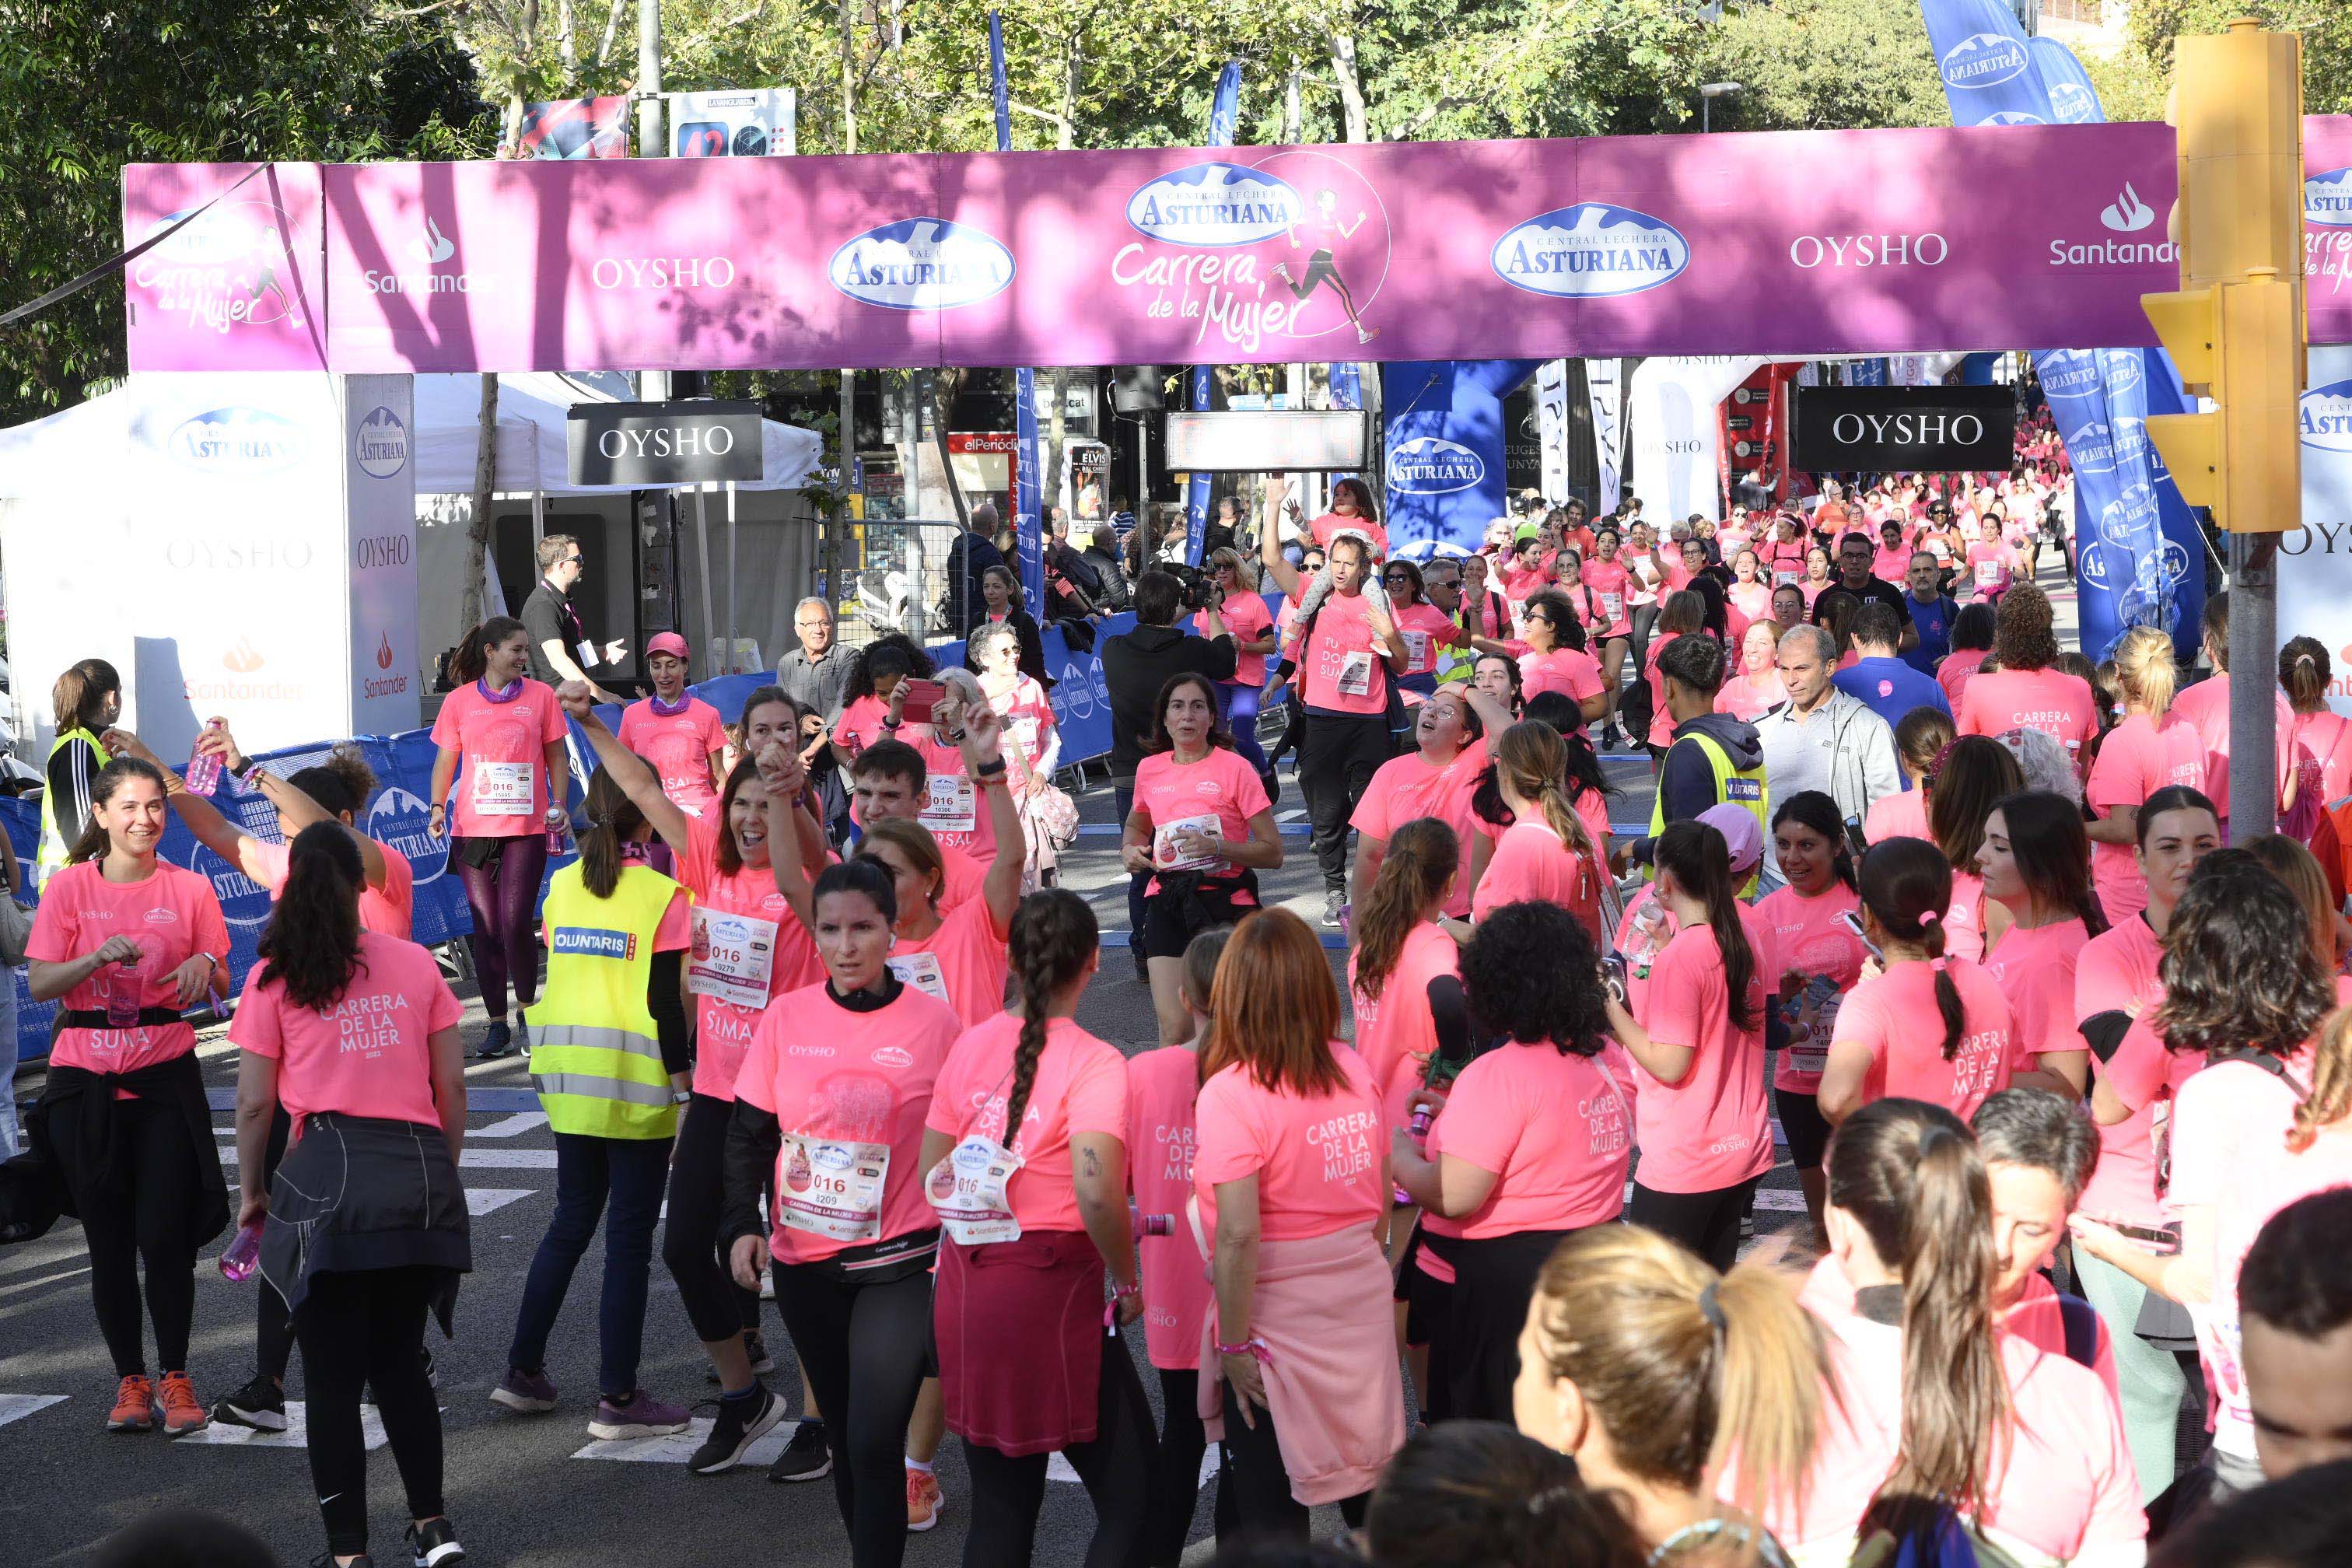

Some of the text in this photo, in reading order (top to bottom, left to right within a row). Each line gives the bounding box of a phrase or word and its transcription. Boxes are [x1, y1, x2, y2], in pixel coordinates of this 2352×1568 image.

[1167, 190, 1223, 200] CENTRAL
[1139, 194, 1290, 226] ASTURIANA
[1537, 233, 1668, 247] CENTRAL LECHERA
[1790, 233, 1948, 268] OYSHO
[1506, 240, 1674, 275] ASTURIANA
[2049, 238, 2182, 266] Santand
[592, 257, 735, 290] OYSHO
[1111, 242, 1258, 285] Carrera
[2322, 254, 2336, 275] la
[1147, 288, 1200, 319] de la
[1195, 280, 1313, 354] Mujer
[1832, 414, 1983, 446] OYSHO
[359, 434, 405, 461] ASTURIANA
[598, 426, 734, 459] OYSHO
[964, 438, 1020, 451] elPeriódi
[1082, 453, 1106, 464] ELVIS
[1390, 460, 1478, 481] ASTURIANA
[166, 537, 313, 570] OYSHO
[358, 534, 409, 569] OYSHO
[1325, 637, 1339, 649] TU
[184, 679, 304, 700] Santander
[364, 674, 408, 699] Santander
[2013, 711, 2071, 724] CARRERA
[2045, 723, 2060, 735] LA
[2169, 759, 2203, 779] ARRERA
[2298, 758, 2336, 771] RRERA
[933, 796, 954, 805] 016
[933, 831, 971, 847] RSAL
[628, 934, 636, 961] 2000
[712, 946, 740, 963] 016
[714, 961, 735, 973] 10279
[90, 978, 111, 999] TU
[691, 979, 761, 1000] OYSHO Santander
[320, 992, 408, 1021] CARRERA
[340, 1013, 394, 1035] DE LA
[1813, 1024, 1836, 1036] 01
[340, 1028, 401, 1053] MUJER
[788, 1045, 835, 1057] OYSHO
[1955, 1055, 1978, 1077] DE
[971, 1091, 1040, 1124] CARA
[1306, 1109, 1379, 1146] CARRERA
[1590, 1116, 1622, 1136] DE LA
[1323, 1133, 1369, 1161] DE LA
[1590, 1131, 1625, 1155] MUJER
[1712, 1138, 1749, 1154] OYSHO
[1170, 1146, 1195, 1164] DE
[1323, 1152, 1372, 1182] MUJER
[814, 1174, 846, 1193] 016
[958, 1178, 978, 1193] 016
[789, 1200, 814, 1213] CARRERA
[831, 1209, 854, 1219] MUJER
